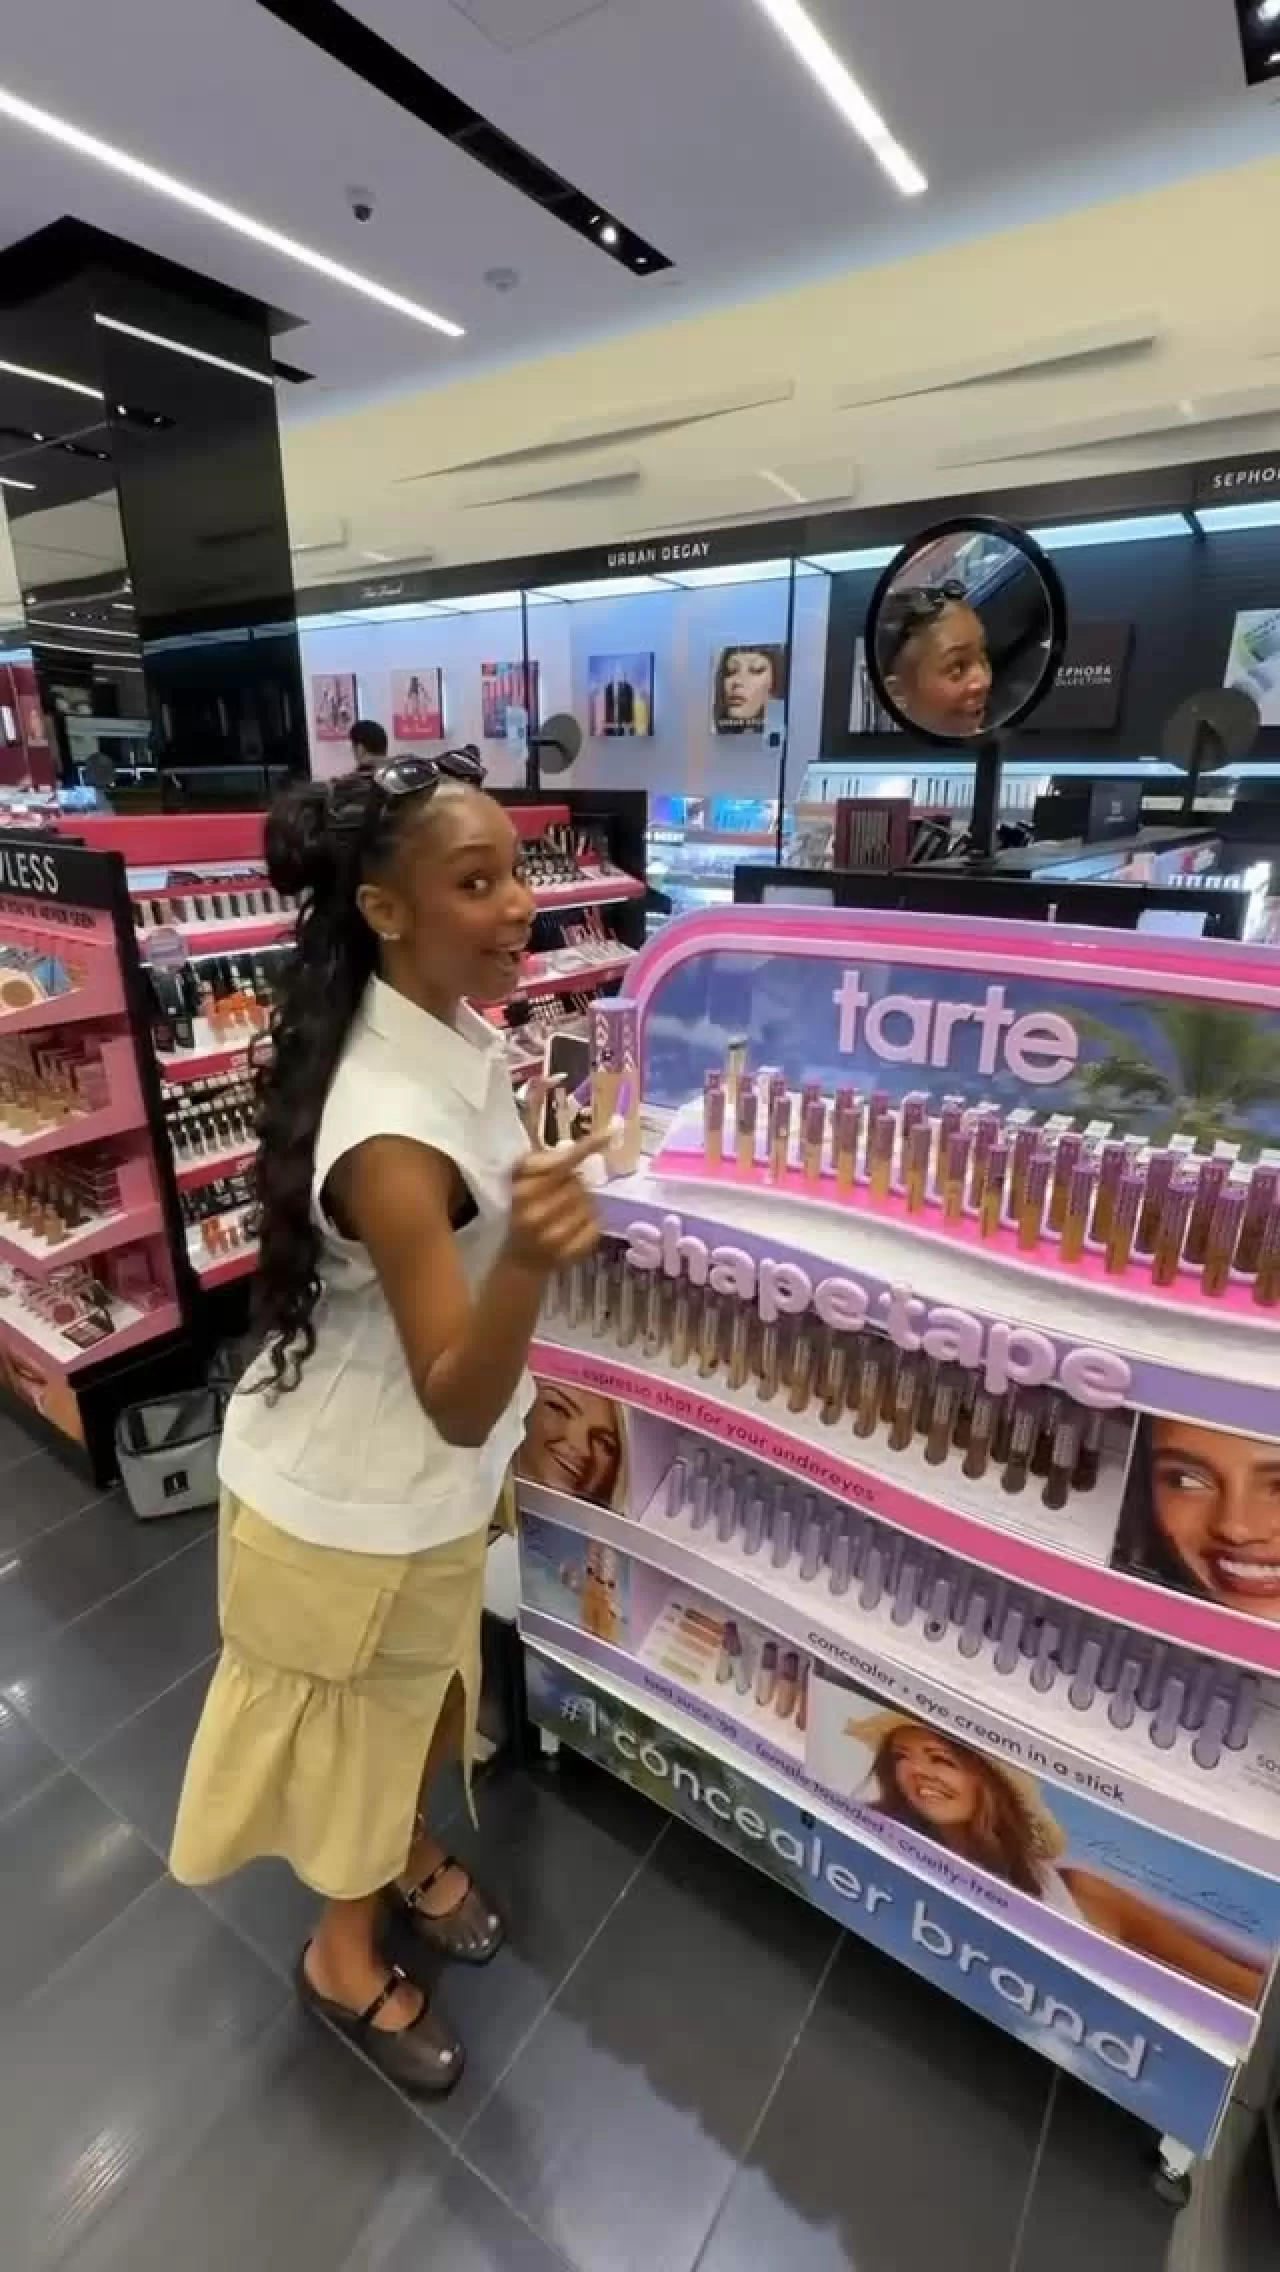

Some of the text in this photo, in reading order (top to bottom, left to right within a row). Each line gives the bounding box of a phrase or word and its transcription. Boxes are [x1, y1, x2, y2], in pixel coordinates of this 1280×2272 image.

[1212, 467, 1280, 488] SEPHO
[607, 543, 710, 567] URBAN DECAY
[1057, 665, 1111, 677] EPHORA
[0, 851, 60, 894] LESS
[833, 969, 1079, 1085] tarte
[625, 1213, 1133, 1409] shape tape
[582, 1369, 652, 1398] espresso
[656, 1391, 692, 1413] shot
[698, 1405, 723, 1424] for
[726, 1423, 768, 1448] your
[771, 1445, 875, 1501] undereyes
[808, 1631, 897, 1686] concealer
[915, 1692, 949, 1717] eye
[954, 1715, 1022, 1756] cream
[1027, 1743, 1048, 1767] in
[1053, 1761, 1069, 1777] a
[1075, 1770, 1124, 1803] stick
[559, 1695, 597, 1736] #1
[612, 1728, 893, 1913] concealer
[912, 1900, 1148, 2080] brand
[756, 1743, 811, 1784] female
[898, 1839, 1009, 1909] cruelty-free
